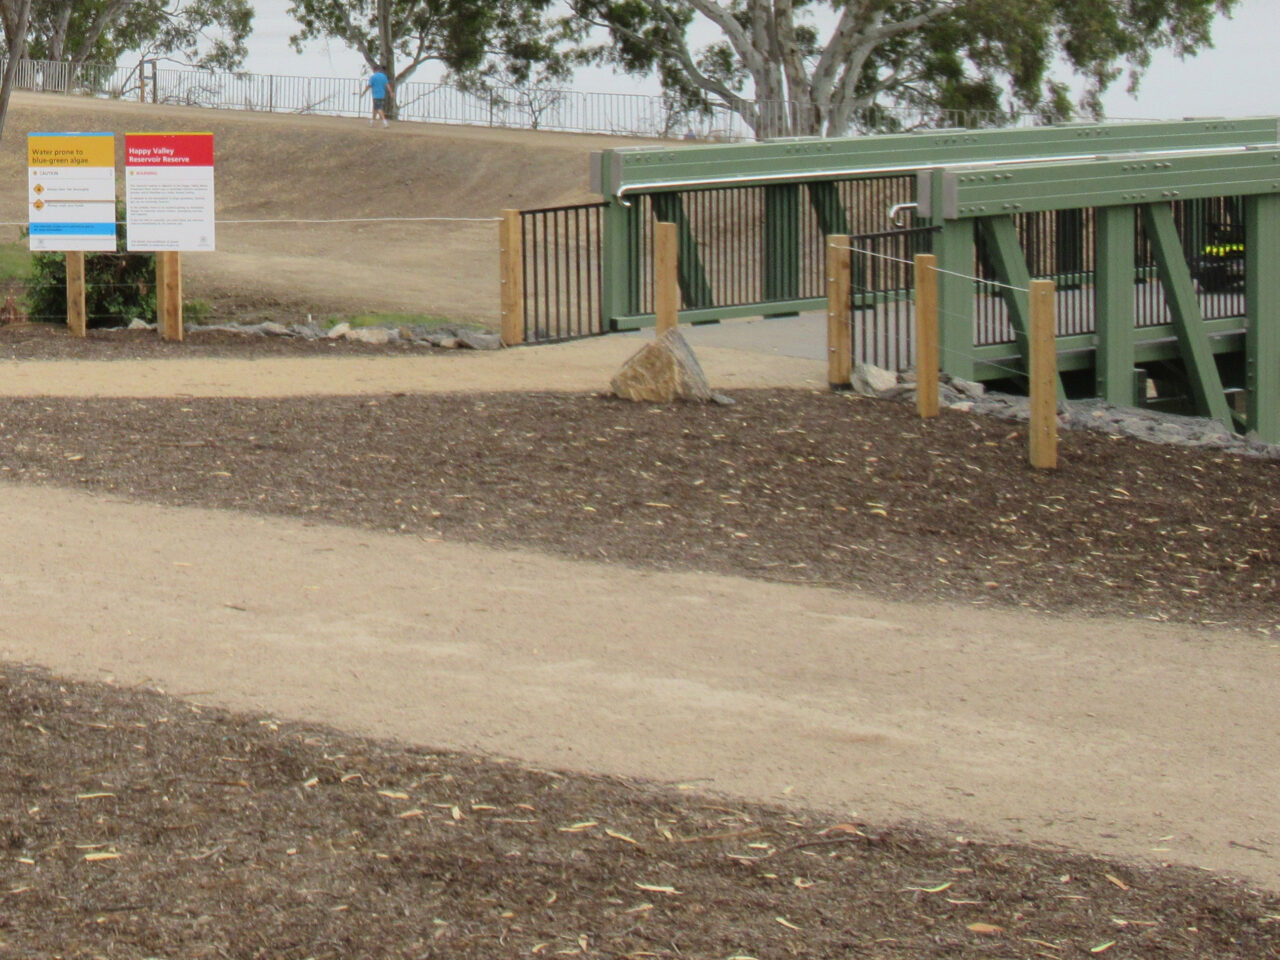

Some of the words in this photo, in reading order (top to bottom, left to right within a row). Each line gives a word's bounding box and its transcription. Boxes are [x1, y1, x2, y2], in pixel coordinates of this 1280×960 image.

[54, 149, 74, 157] prone
[129, 148, 151, 156] Happy
[153, 147, 174, 156] Valley
[32, 157, 68, 165] blue-green
[70, 157, 89, 165] algae
